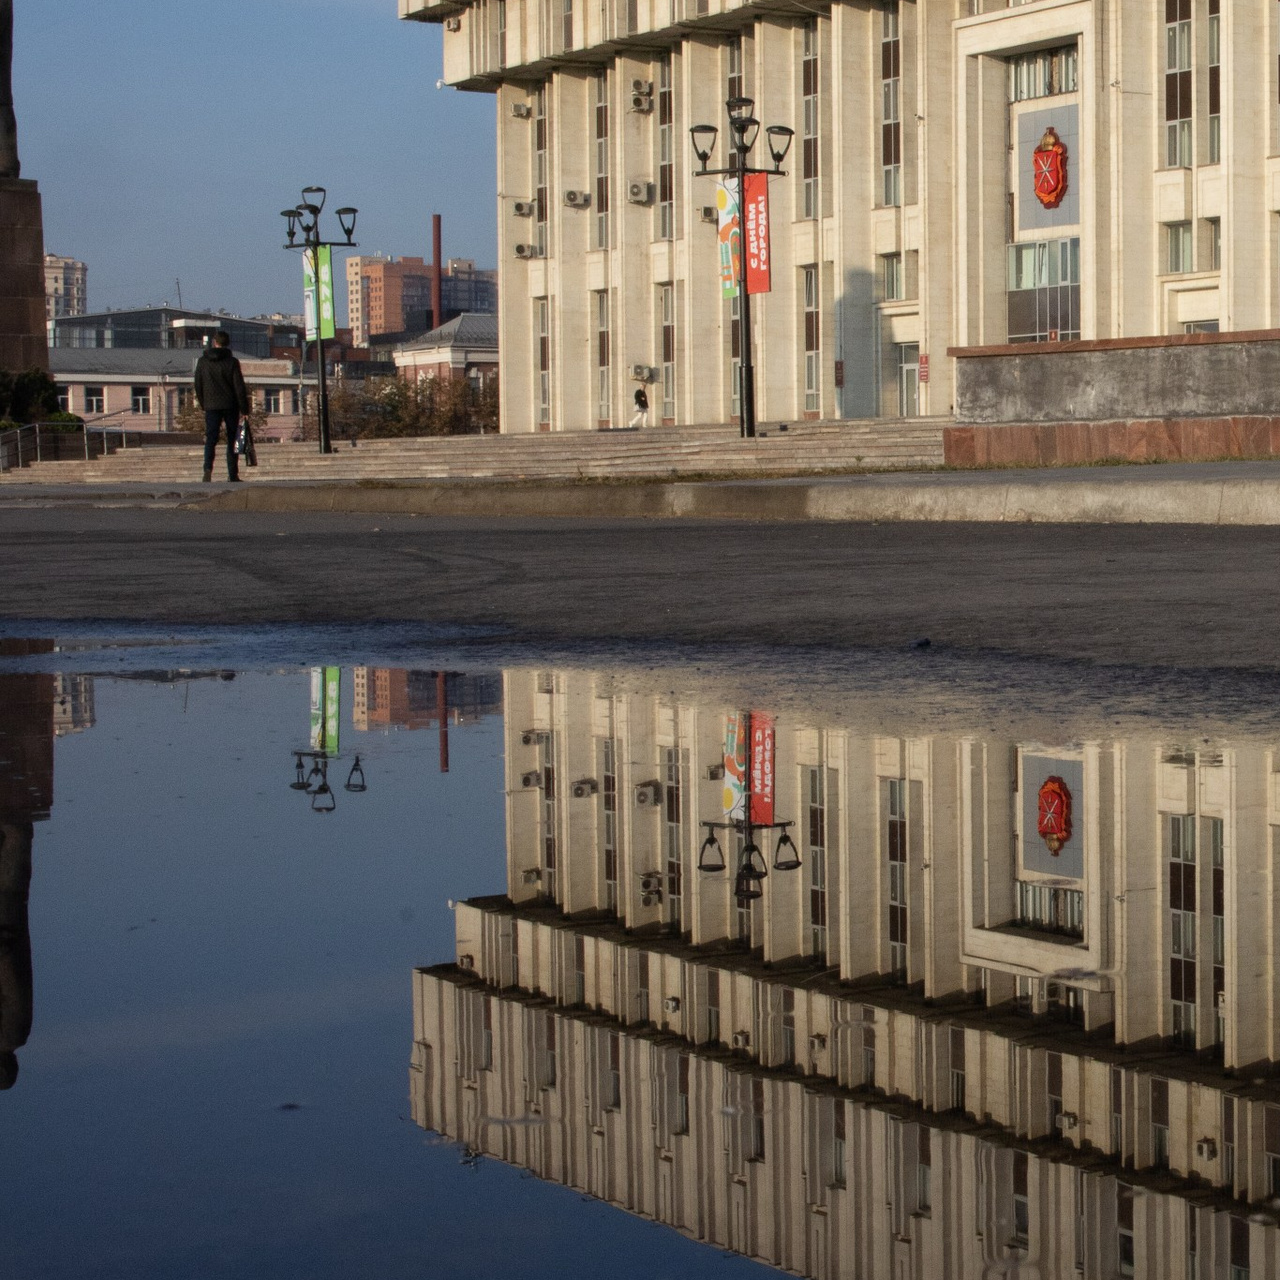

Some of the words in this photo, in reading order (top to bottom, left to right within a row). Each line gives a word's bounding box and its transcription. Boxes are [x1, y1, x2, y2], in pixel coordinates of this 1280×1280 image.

[747, 203, 758, 254] ДНЁМ
[758, 196, 767, 270] ГОРОДА!
[750, 258, 758, 269] С
[321, 264, 331, 320] 878
